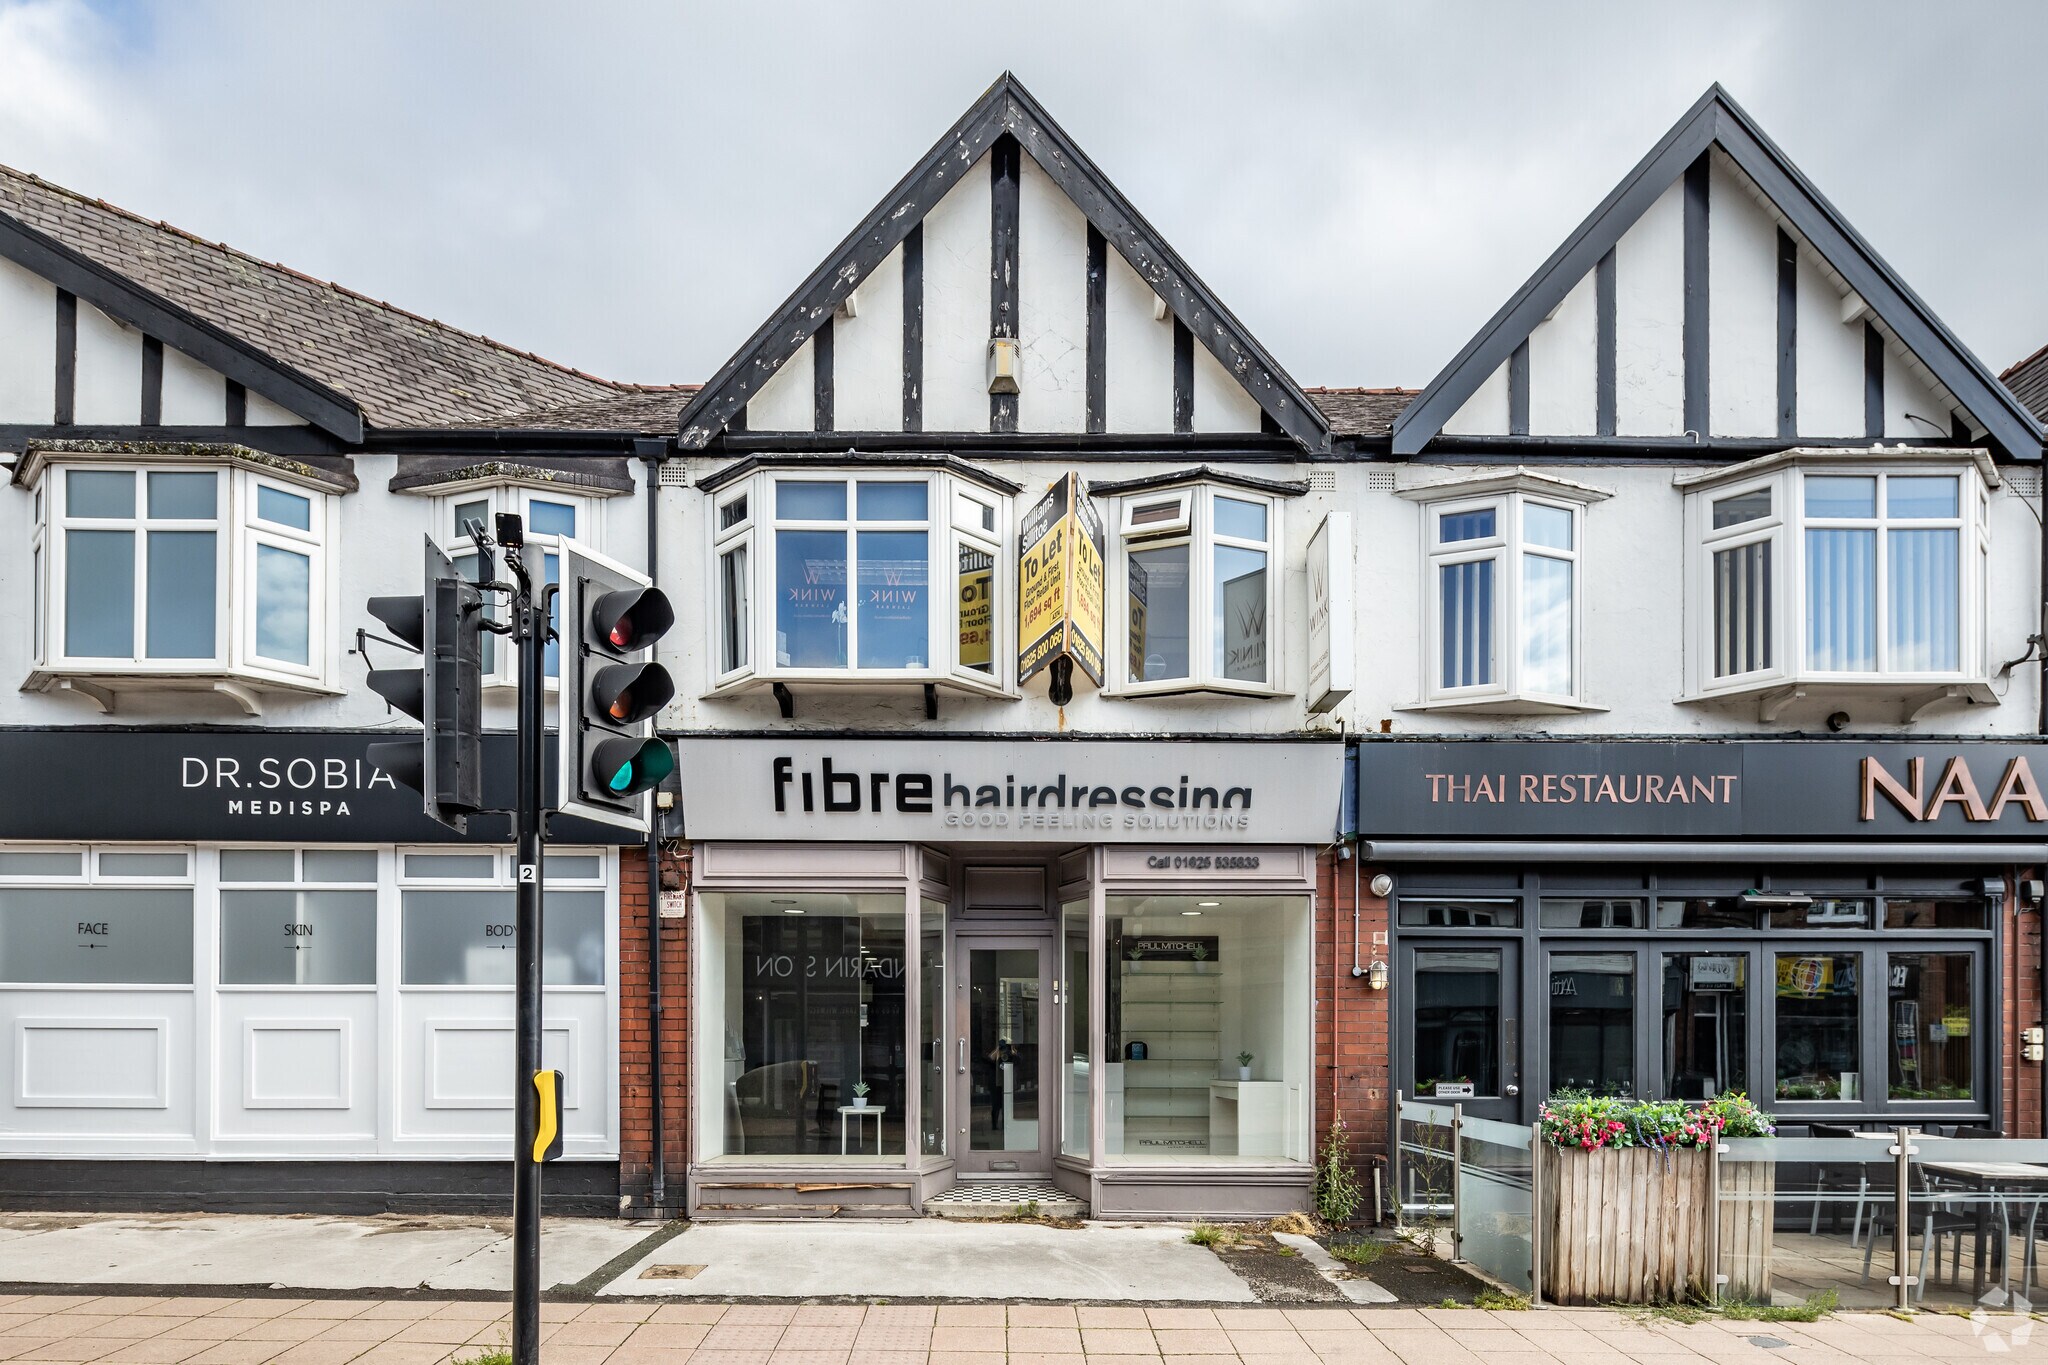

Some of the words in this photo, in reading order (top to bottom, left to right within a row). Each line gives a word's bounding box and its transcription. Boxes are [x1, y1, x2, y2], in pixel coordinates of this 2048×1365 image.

[1022, 493, 1054, 535] Williams
[1024, 554, 1038, 583] To
[1042, 528, 1062, 568] Let
[1078, 527, 1087, 563] To
[1089, 548, 1101, 588] Let
[1024, 596, 1035, 611] Floor
[1036, 580, 1049, 600] Retail
[1050, 570, 1061, 587] Unit
[1026, 575, 1042, 598] Ground
[1048, 560, 1059, 578] First
[1025, 602, 1042, 629] 1,694
[1043, 596, 1052, 611] sq
[1053, 586, 1060, 602] ft
[1020, 649, 1037, 673] 01625
[1037, 639, 1049, 660] 800
[1050, 628, 1063, 650] 066
[773, 756, 933, 813] fibre
[944, 773, 1252, 809] hairdressing
[1425, 774, 1506, 803] THAI
[1519, 774, 1737, 803] RESTAURANT
[228, 800, 351, 816] MEDISPA
[944, 811, 1010, 827] GOOD
[1019, 813, 1113, 829] FEELING
[1123, 813, 1251, 830] SOLUTIONS
[523, 867, 532, 880] 2
[1147, 856, 1171, 869] Call
[77, 922, 109, 936] FACE
[284, 923, 313, 937] SKIN
[1138, 942, 1161, 950] PAUL
